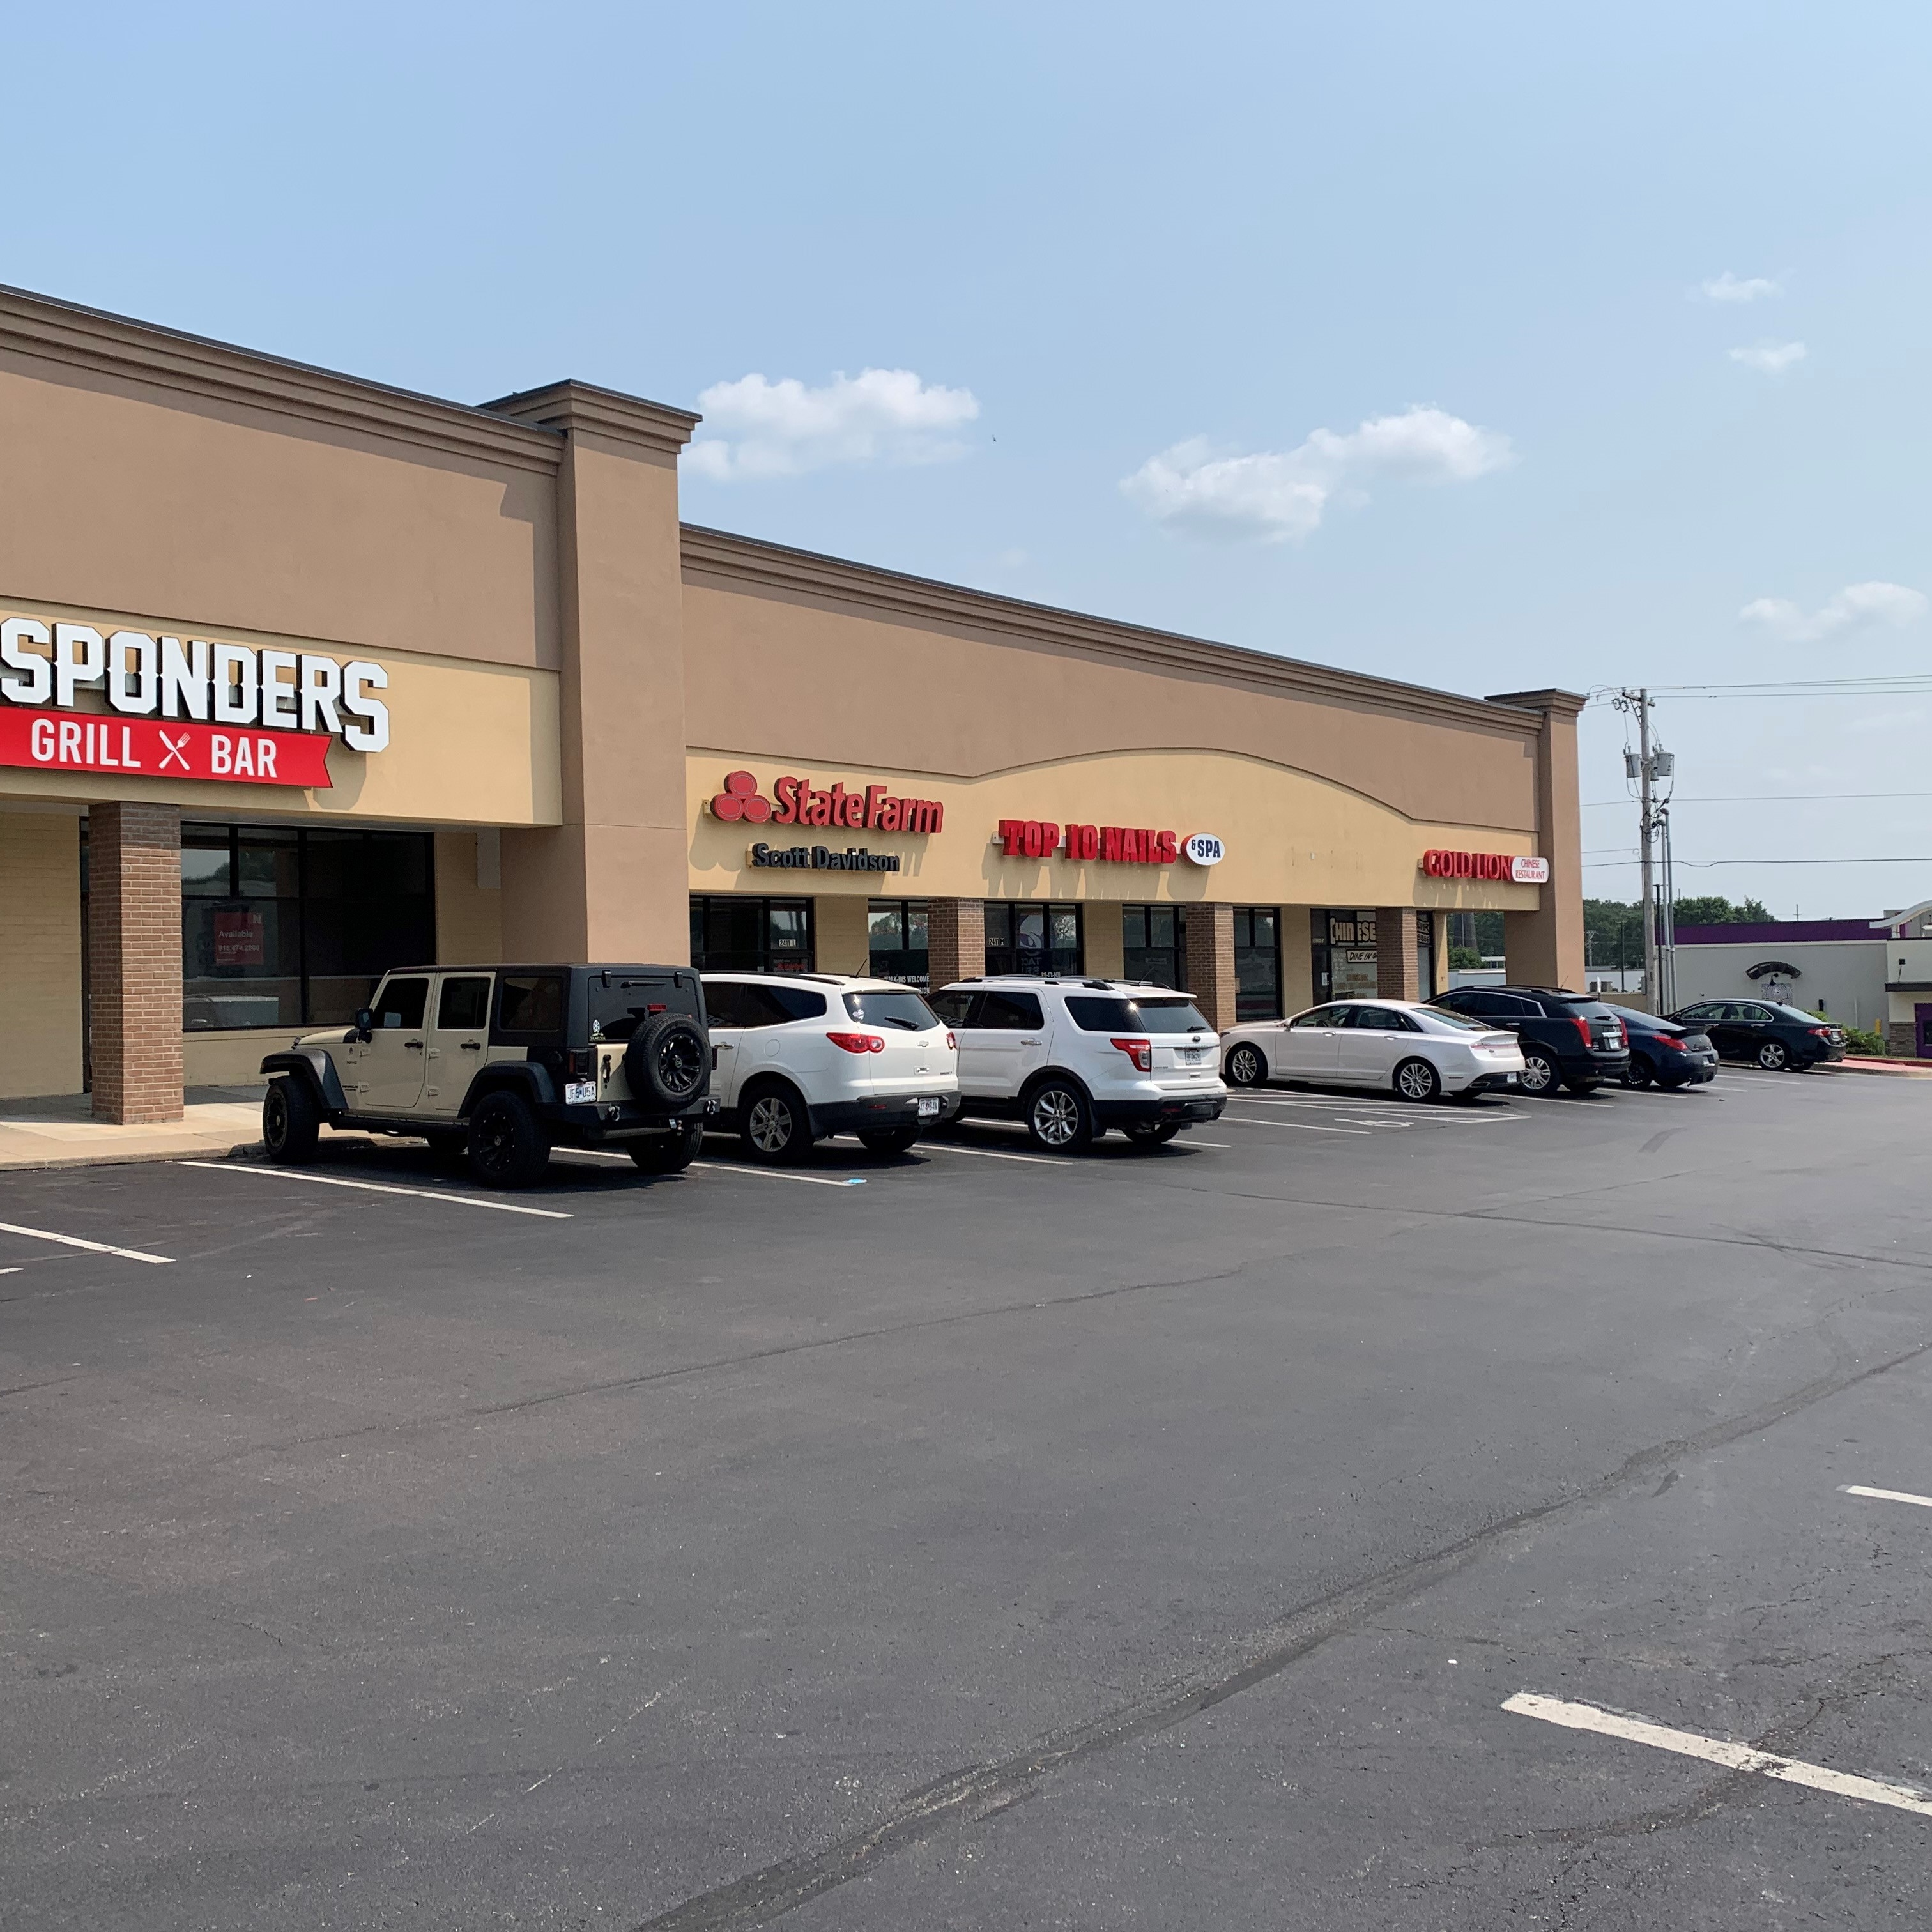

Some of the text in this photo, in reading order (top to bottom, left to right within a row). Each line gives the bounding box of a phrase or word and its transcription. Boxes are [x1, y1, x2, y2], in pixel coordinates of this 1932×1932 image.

[0, 617, 390, 753] SPONDERS
[31, 718, 277, 778] GRILL BAR
[999, 820, 1059, 858] TOP
[1065, 824, 1098, 860] 10
[1100, 827, 1176, 864] NAILS
[1197, 839, 1221, 858] SPA
[752, 843, 900, 871] Scott Davidson
[1423, 850, 1512, 881] GOLD LION
[1521, 859, 1540, 868] CHINESE
[1515, 870, 1545, 880] RESTAURANT
[1330, 917, 1376, 945] CHINESE
[1363, 952, 1372, 960] IN
